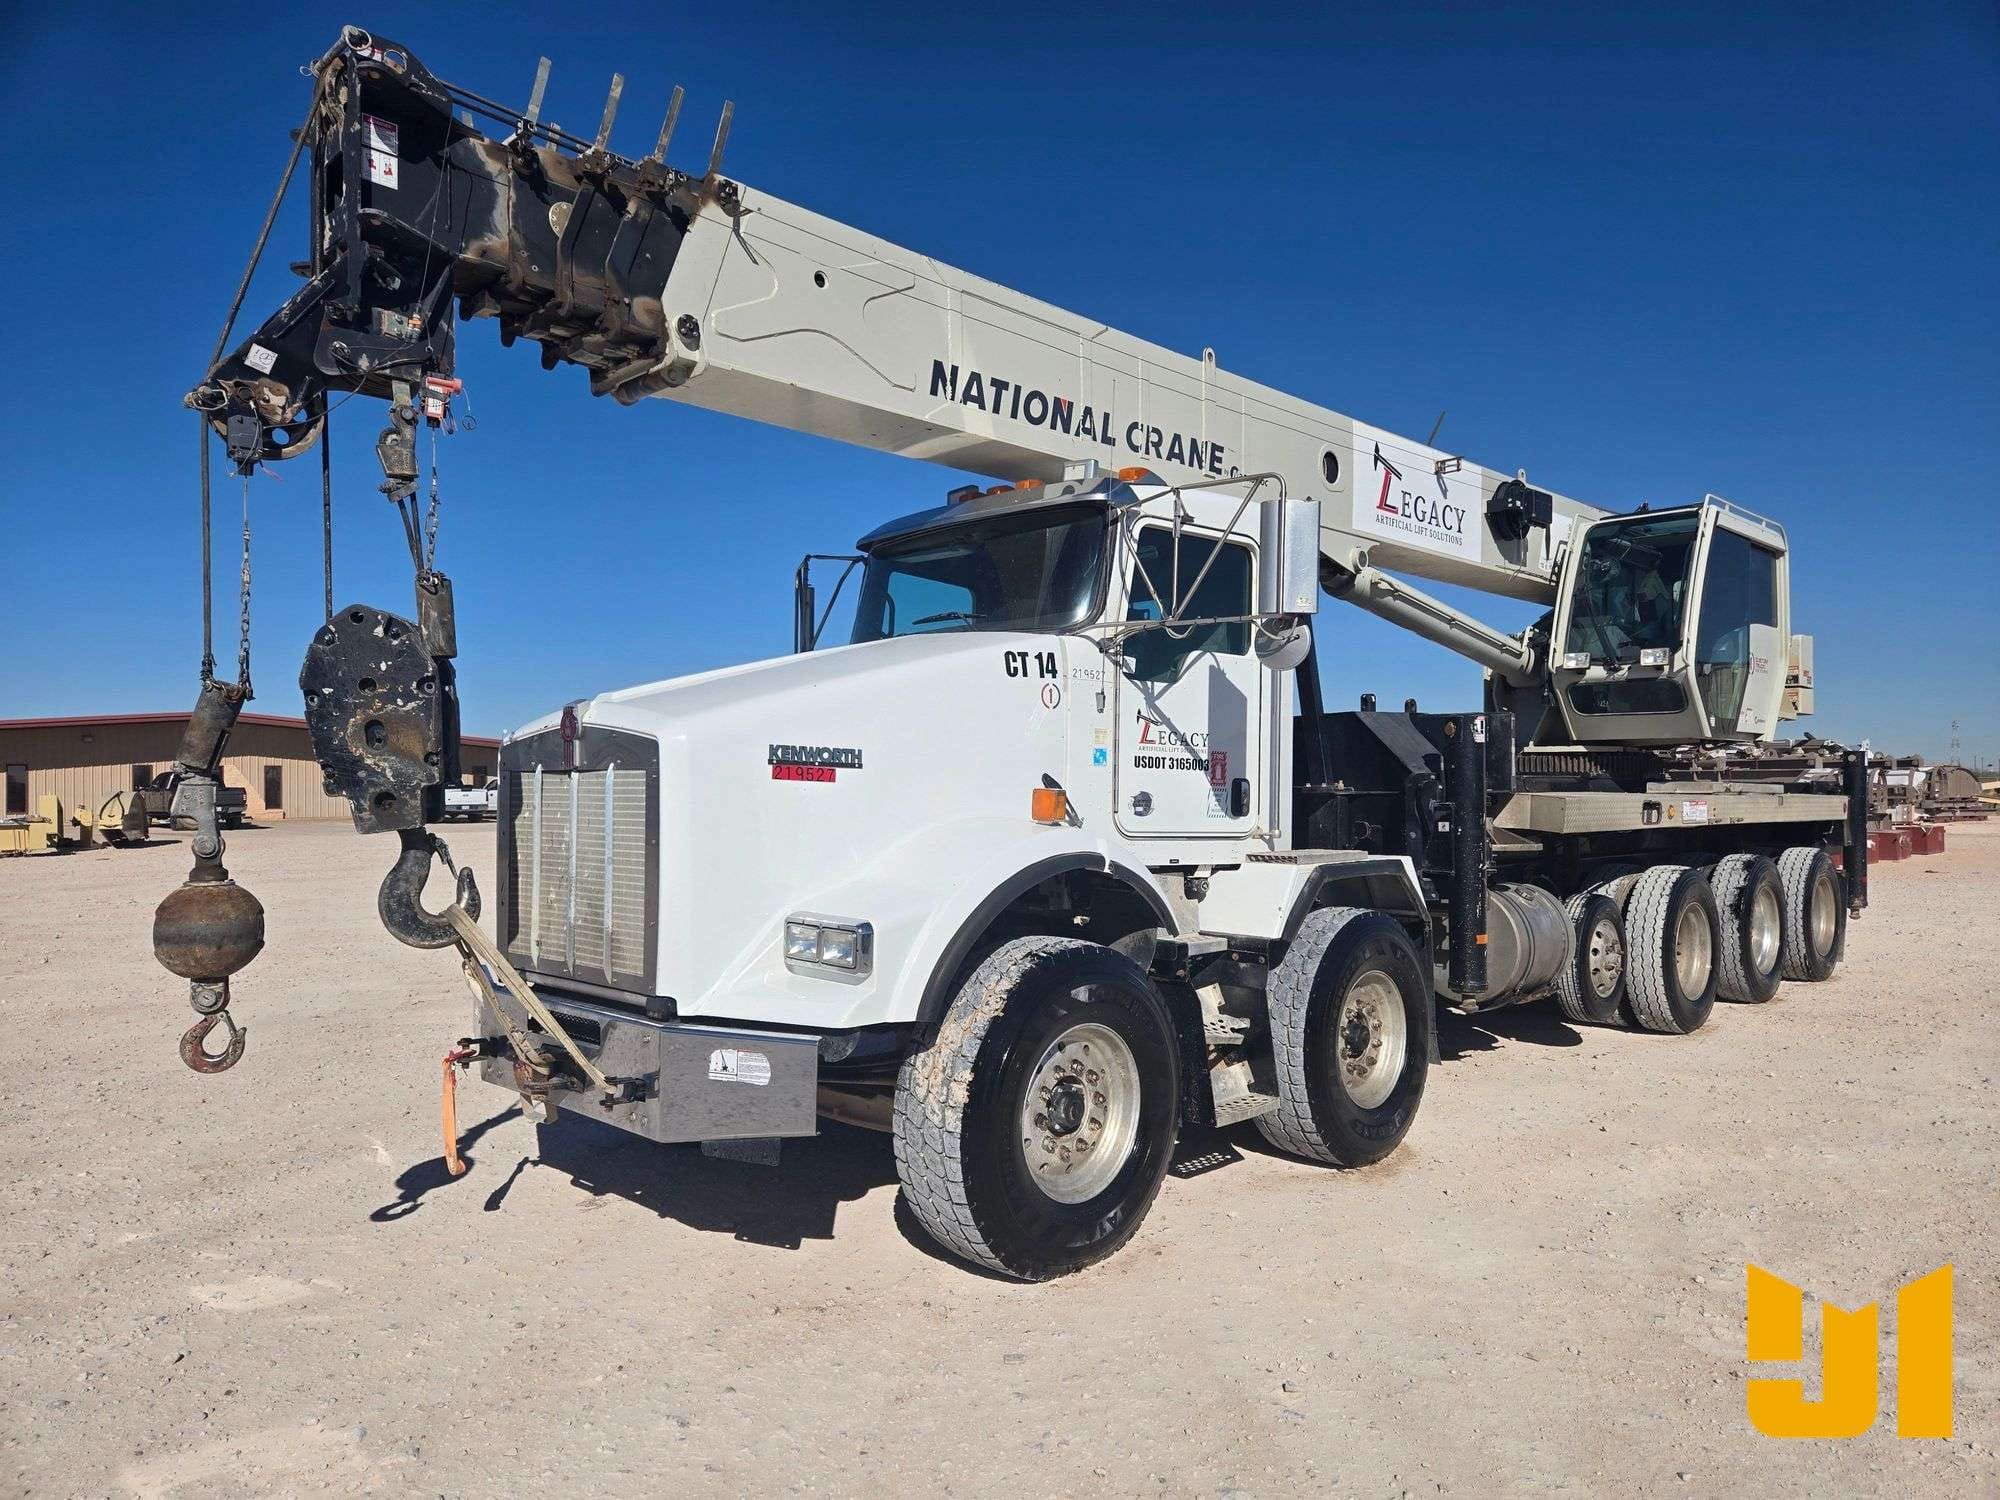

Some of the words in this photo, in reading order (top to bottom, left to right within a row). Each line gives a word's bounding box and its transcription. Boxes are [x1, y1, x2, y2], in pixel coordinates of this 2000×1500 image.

[930, 359, 1116, 447] NATIONAL
[1126, 421, 1223, 476] CRANE
[1376, 466, 1466, 534] LEGACY
[1375, 514, 1413, 532] ARTIFICIAL
[1414, 524, 1428, 537] LIFT
[1429, 528, 1463, 546] SOLUTIONS
[1004, 650, 1029, 678] CT
[1034, 651, 1058, 679] 14
[1072, 668, 1106, 680] 219527
[1138, 720, 1210, 747] LEGACY
[768, 744, 863, 764] KENWORTH
[1134, 755, 1167, 769] USDOT
[1168, 757, 1210, 771] 3165003
[774, 765, 835, 781] 219527
